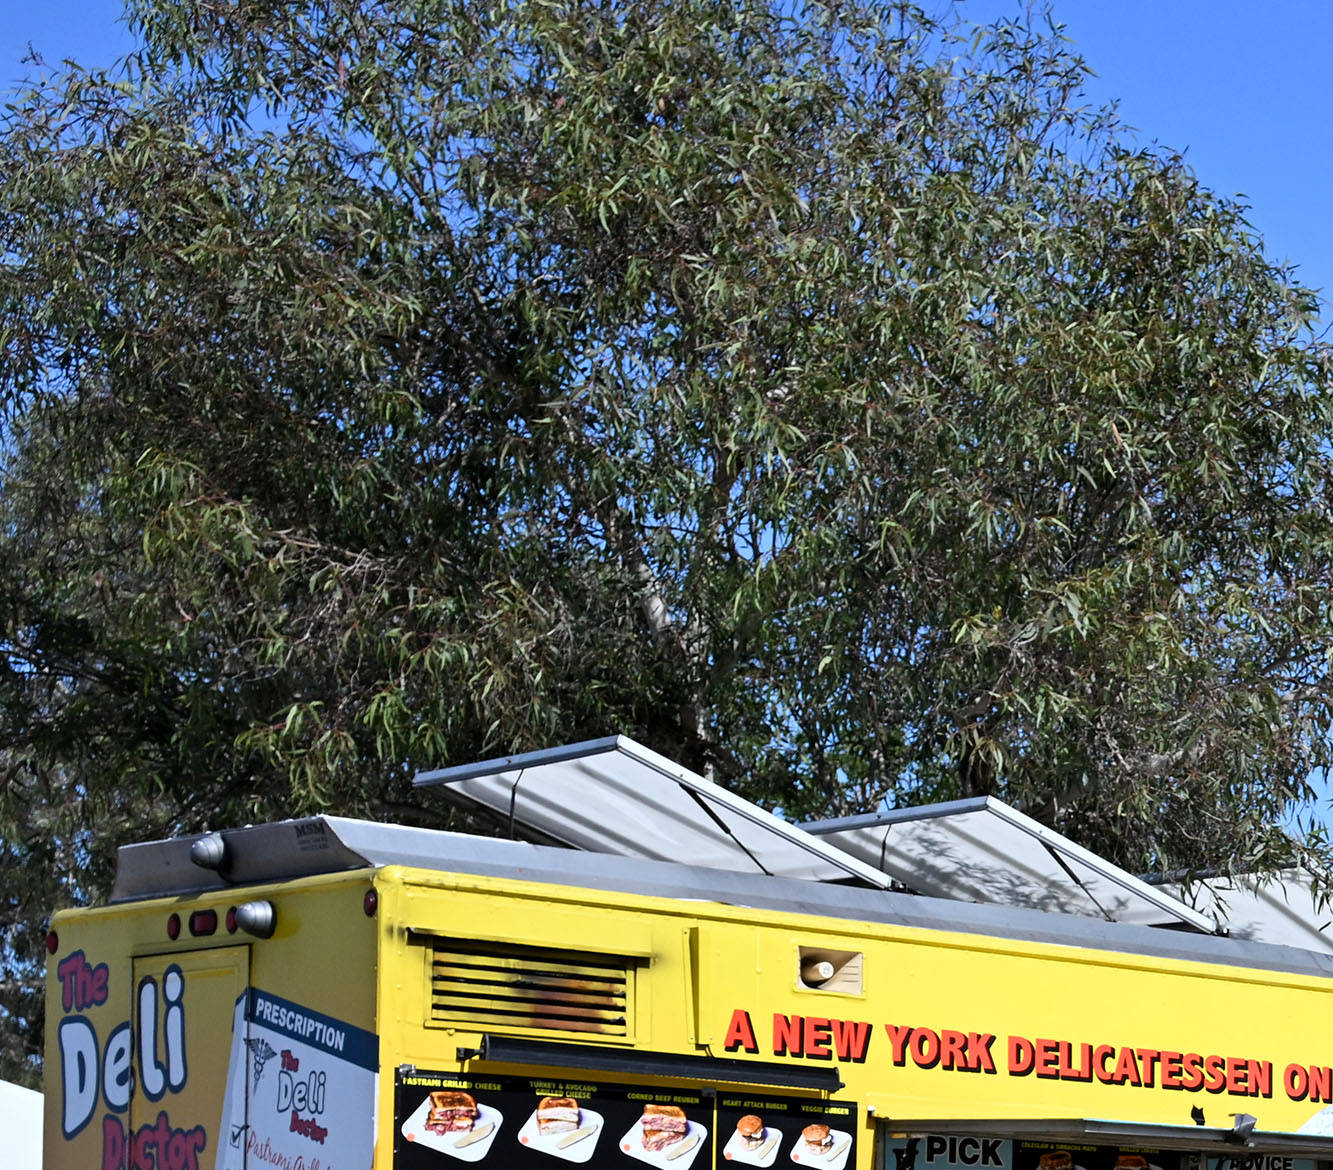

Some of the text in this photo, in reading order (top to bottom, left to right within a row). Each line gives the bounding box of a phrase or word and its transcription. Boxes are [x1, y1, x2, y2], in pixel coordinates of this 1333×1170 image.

[58, 949, 109, 1012] The
[256, 998, 345, 1051] PRESCRIPTION
[58, 963, 187, 1141] Deli
[280, 1050, 299, 1072] The
[723, 1009, 757, 1053] A
[772, 1013, 872, 1064] NEW
[885, 1023, 996, 1074] YORK
[1007, 1034, 1273, 1099] DELICATESSEN
[1283, 1055, 1333, 1104] ON
[276, 1070, 327, 1114] Deli
[475, 1081, 502, 1091] CHEESE
[289, 1110, 328, 1145] Doctor
[925, 1135, 1004, 1167] PICK
